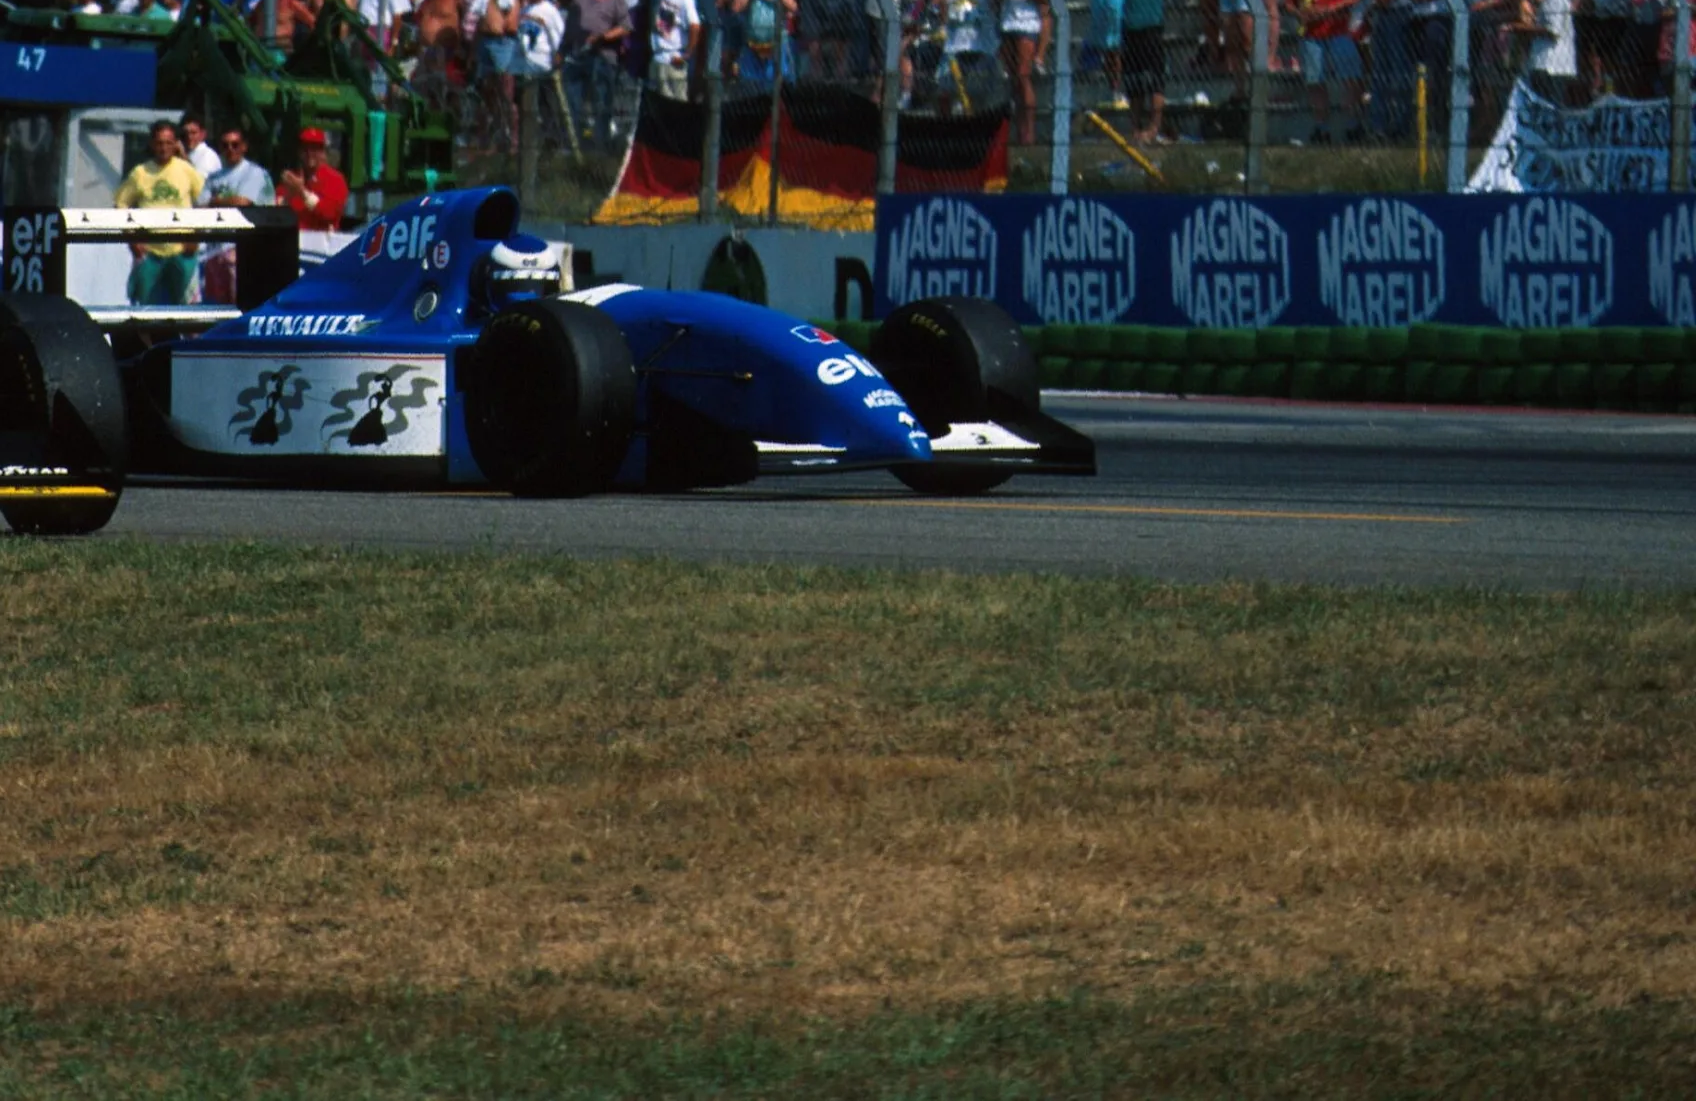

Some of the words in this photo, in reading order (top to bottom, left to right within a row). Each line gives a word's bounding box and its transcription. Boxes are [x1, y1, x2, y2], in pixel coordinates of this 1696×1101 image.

[17, 47, 46, 72] 47
[387, 215, 437, 260] elf
[247, 313, 368, 336] RENAULT
